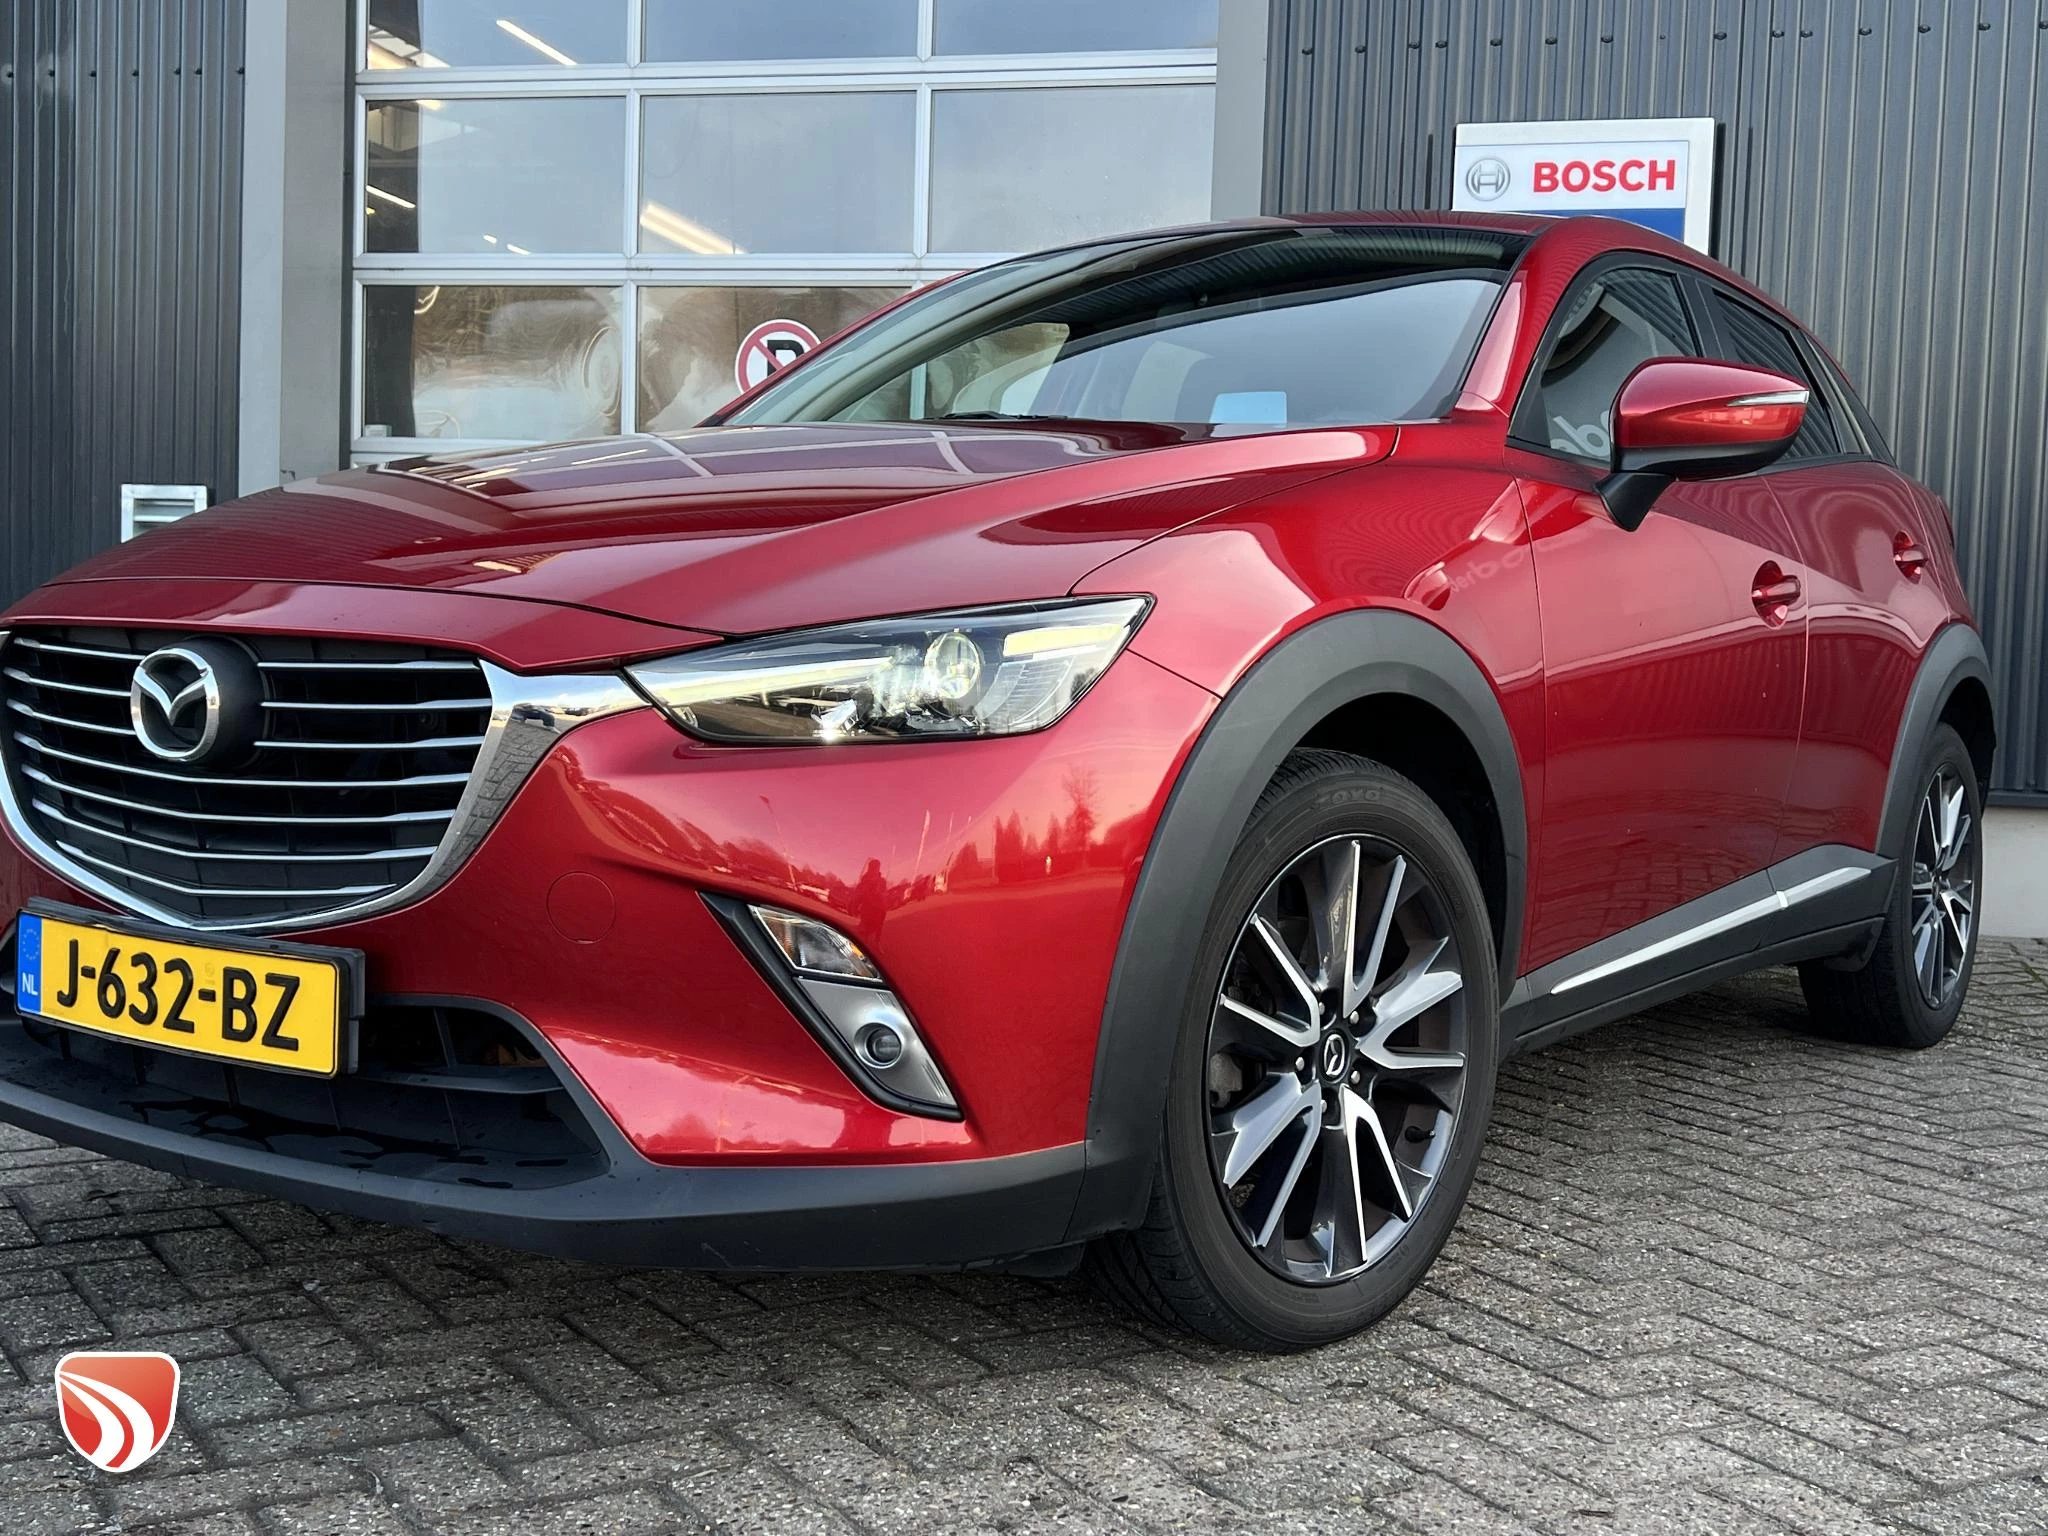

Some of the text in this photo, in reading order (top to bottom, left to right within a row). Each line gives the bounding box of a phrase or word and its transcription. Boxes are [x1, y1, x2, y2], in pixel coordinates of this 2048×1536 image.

[1533, 160, 1675, 193] BOSCH
[22, 972, 39, 996] NL
[57, 939, 300, 1051] J-632-BZ
